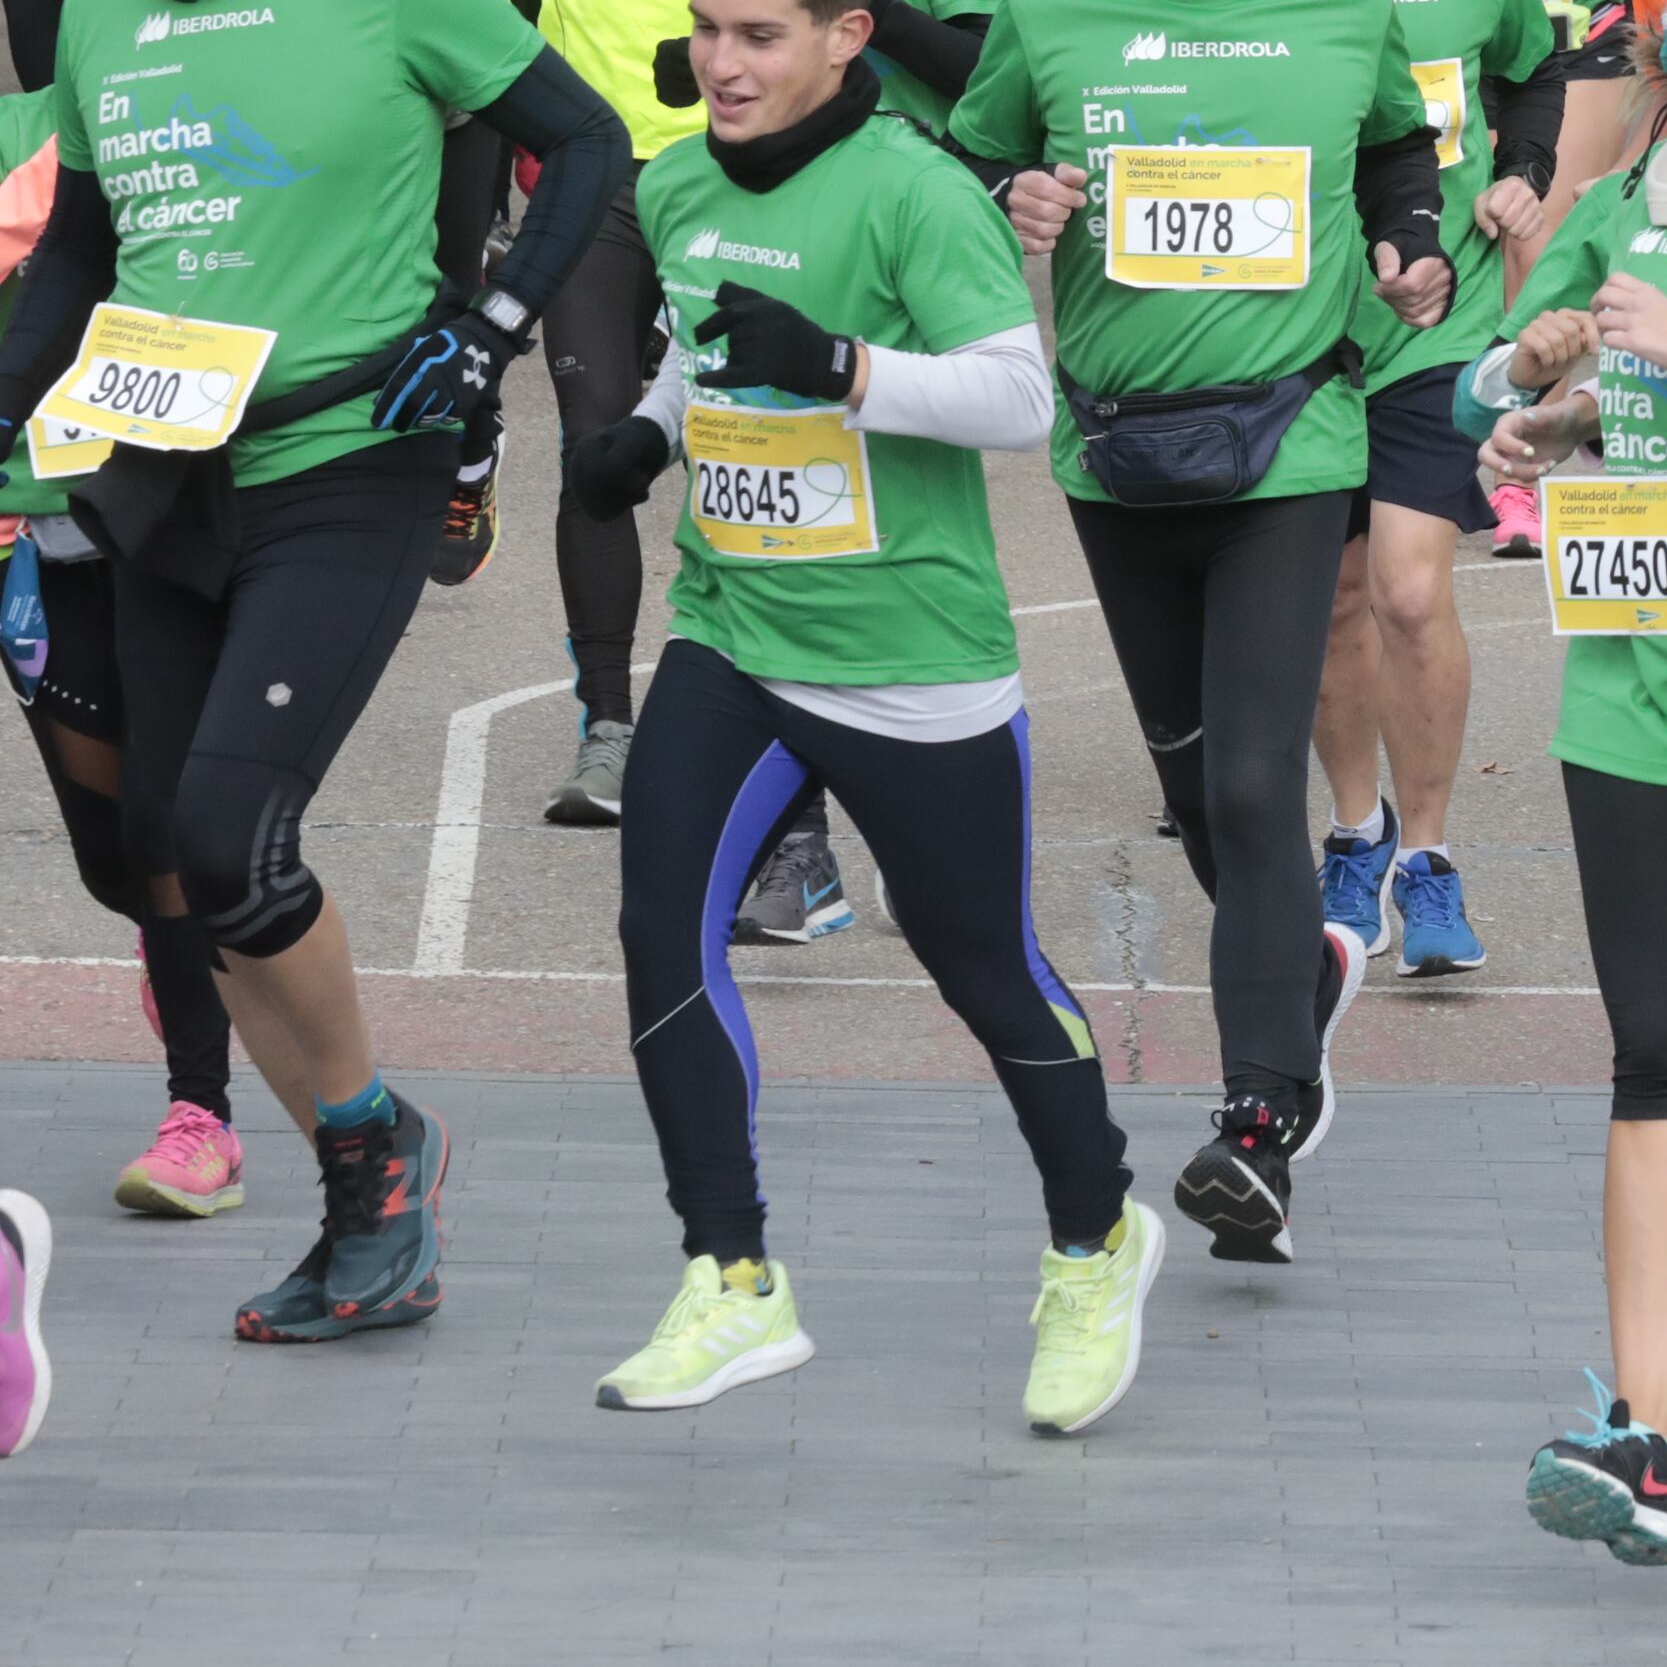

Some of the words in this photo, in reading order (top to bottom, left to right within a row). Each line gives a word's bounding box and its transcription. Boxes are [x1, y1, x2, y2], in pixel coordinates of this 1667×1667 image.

[172, 7, 275, 36] IBERDROLA
[1170, 40, 1291, 60] IBERDROLA
[138, 63, 183, 79] Valladolid
[1093, 84, 1131, 97] Edición
[1132, 83, 1187, 96] Valladolid
[99, 91, 130, 125] En
[1083, 103, 1126, 135] En
[99, 117, 213, 164] marcha
[1126, 156, 1187, 169] Valladolid
[1189, 159, 1204, 168] en
[1207, 157, 1253, 170] marcha
[1126, 170, 1162, 181] contra
[1166, 169, 1178, 181] el
[1180, 169, 1223, 182] cáncer
[103, 160, 199, 200] contra
[136, 196, 242, 231] cáncer
[1144, 200, 1234, 255] 1978
[716, 241, 800, 271] IBERDROLA
[102, 315, 160, 337] Valladolid
[98, 327, 135, 345] contra
[136, 333, 148, 346] el
[148, 335, 187, 353] cáncer
[88, 361, 182, 420] 9800
[692, 413, 738, 431] Valladolid
[692, 427, 719, 441] contra
[723, 430, 733, 443] el
[733, 431, 769, 447] cáncer
[698, 462, 801, 525] 28645
[1559, 489, 1618, 503] Valladolid
[1619, 492, 1632, 502] en
[1559, 504, 1595, 516] contra
[1598, 503, 1609, 516] el
[1611, 502, 1648, 516] cáncer
